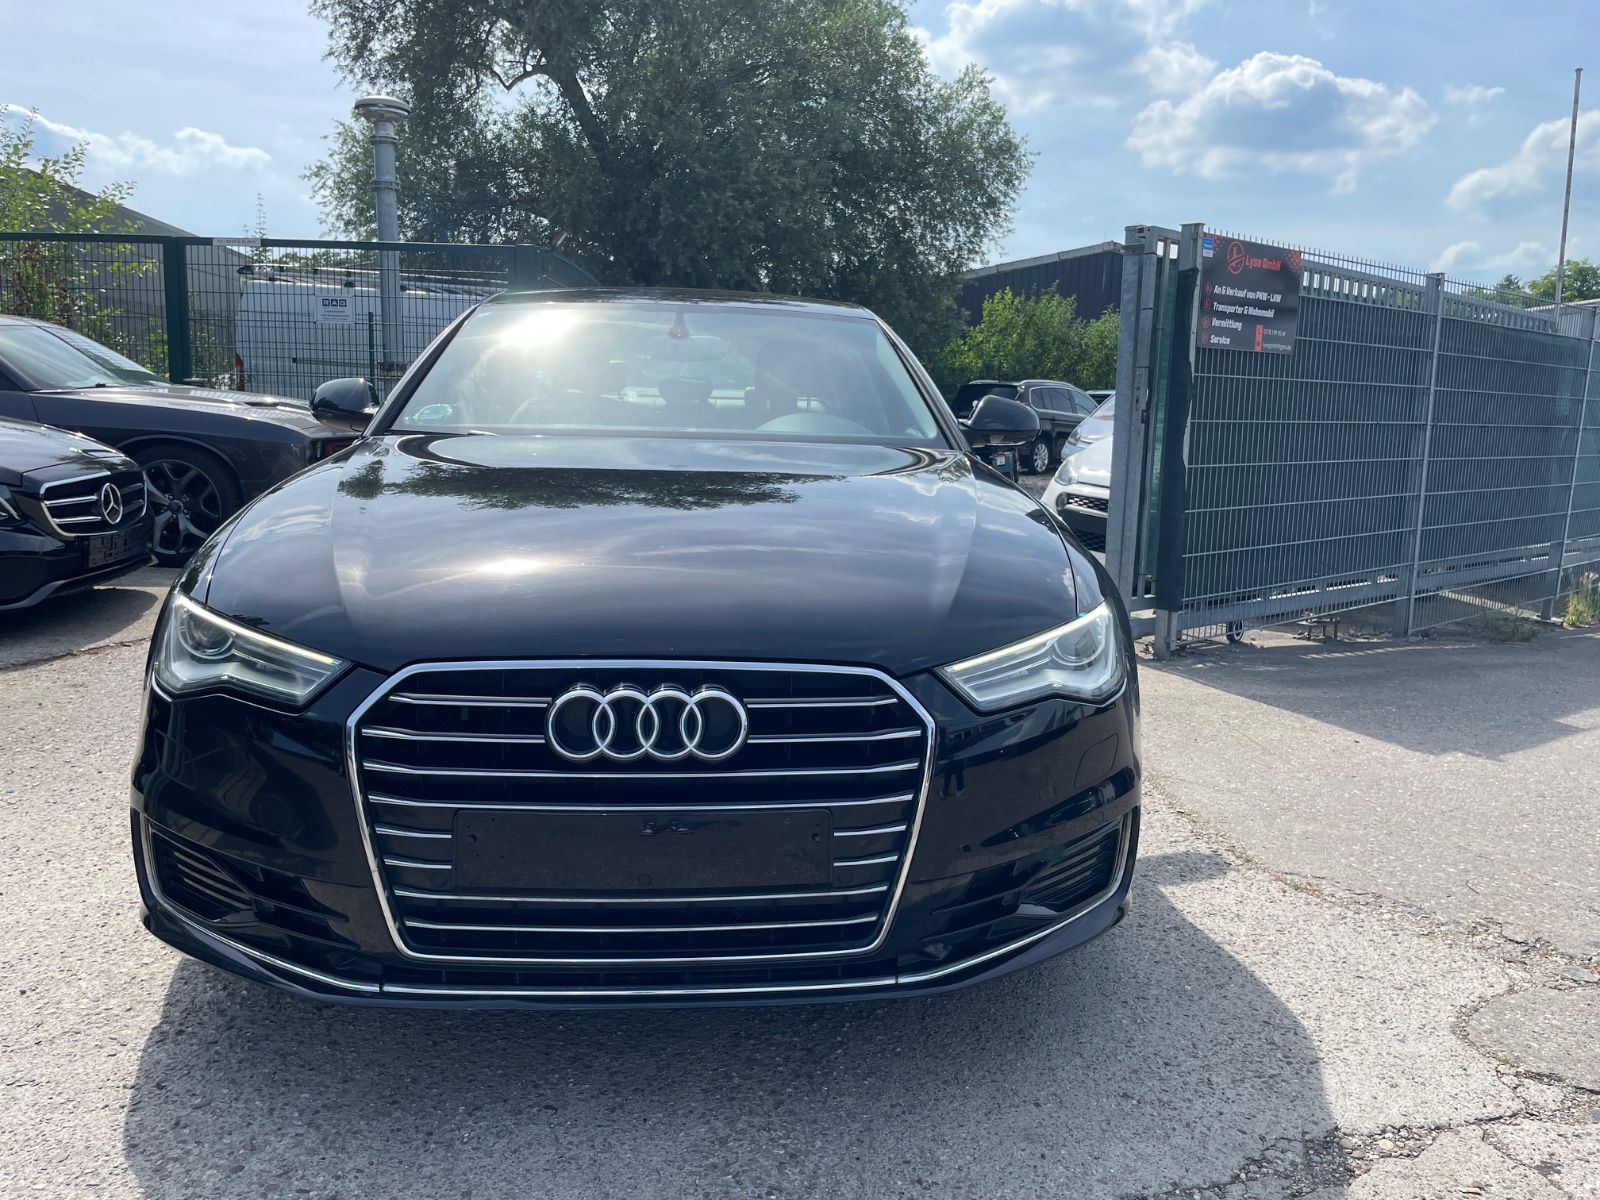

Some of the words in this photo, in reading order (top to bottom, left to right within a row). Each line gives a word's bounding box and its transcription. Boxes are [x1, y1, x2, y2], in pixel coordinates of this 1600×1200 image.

[1262, 257, 1281, 271] GmbH
[322, 289, 347, 307] RAG
[1213, 285, 1222, 295] An
[1226, 287, 1247, 298] Verkauf
[1246, 290, 1256, 299] von
[1255, 291, 1268, 301] PKW
[1270, 293, 1282, 303] LKW
[1213, 302, 1243, 314] Transporter
[1248, 306, 1275, 318] Wohnmobil
[1211, 317, 1243, 331] Vermittlung
[1210, 334, 1231, 345] Service
